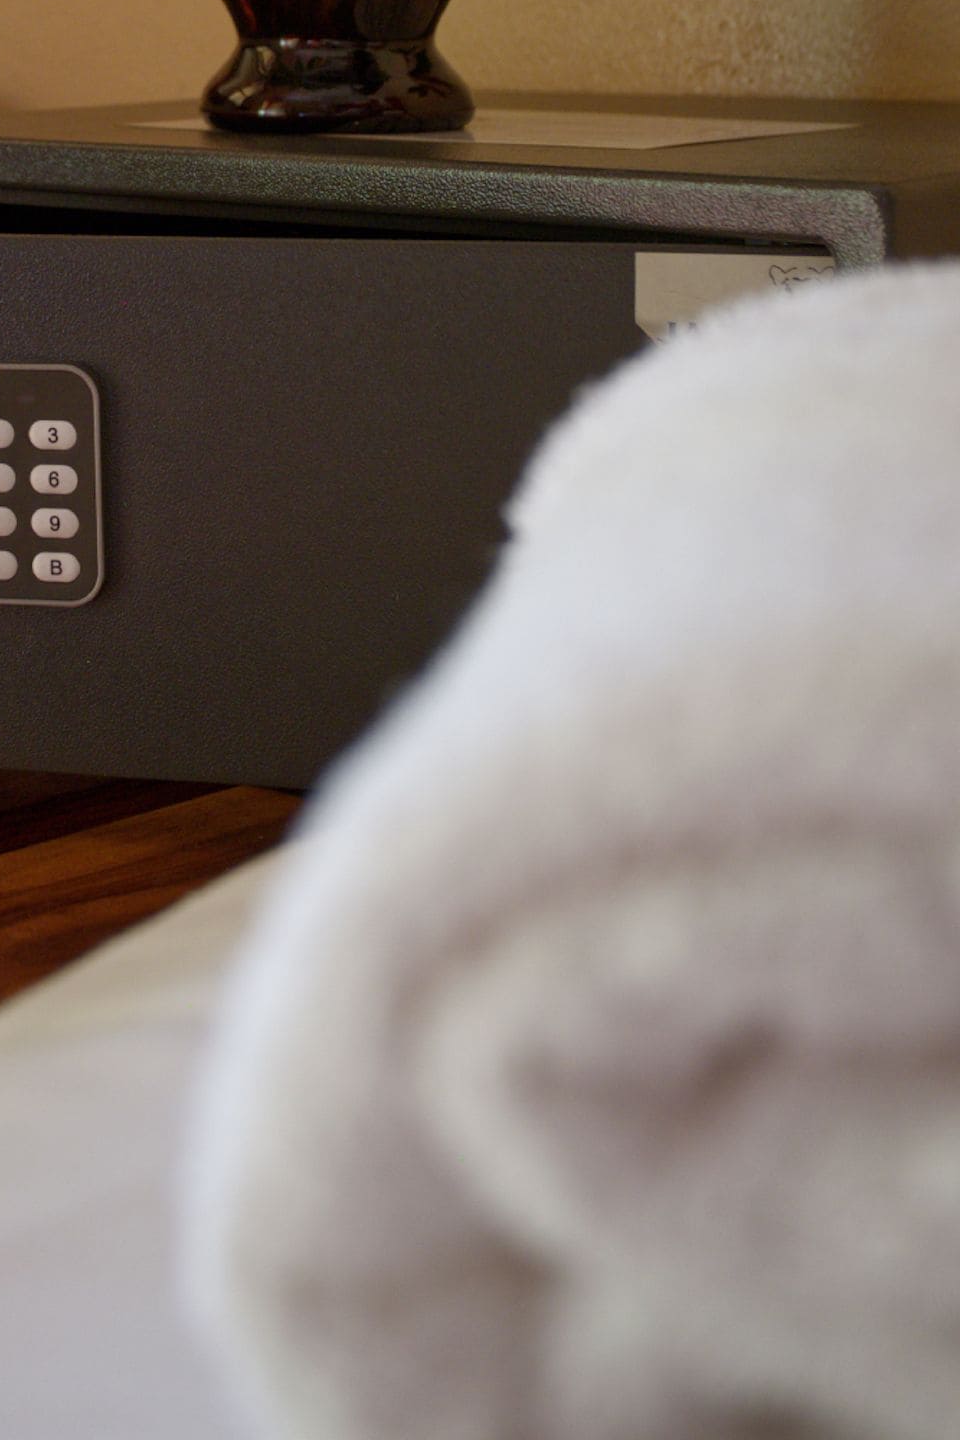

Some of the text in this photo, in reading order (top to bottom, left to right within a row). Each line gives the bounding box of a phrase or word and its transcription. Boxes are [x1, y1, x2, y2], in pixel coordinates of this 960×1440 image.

[48, 427, 58, 443] 3
[49, 472, 59, 487] 6
[50, 515, 60, 531] 9
[51, 560, 62, 575] B
